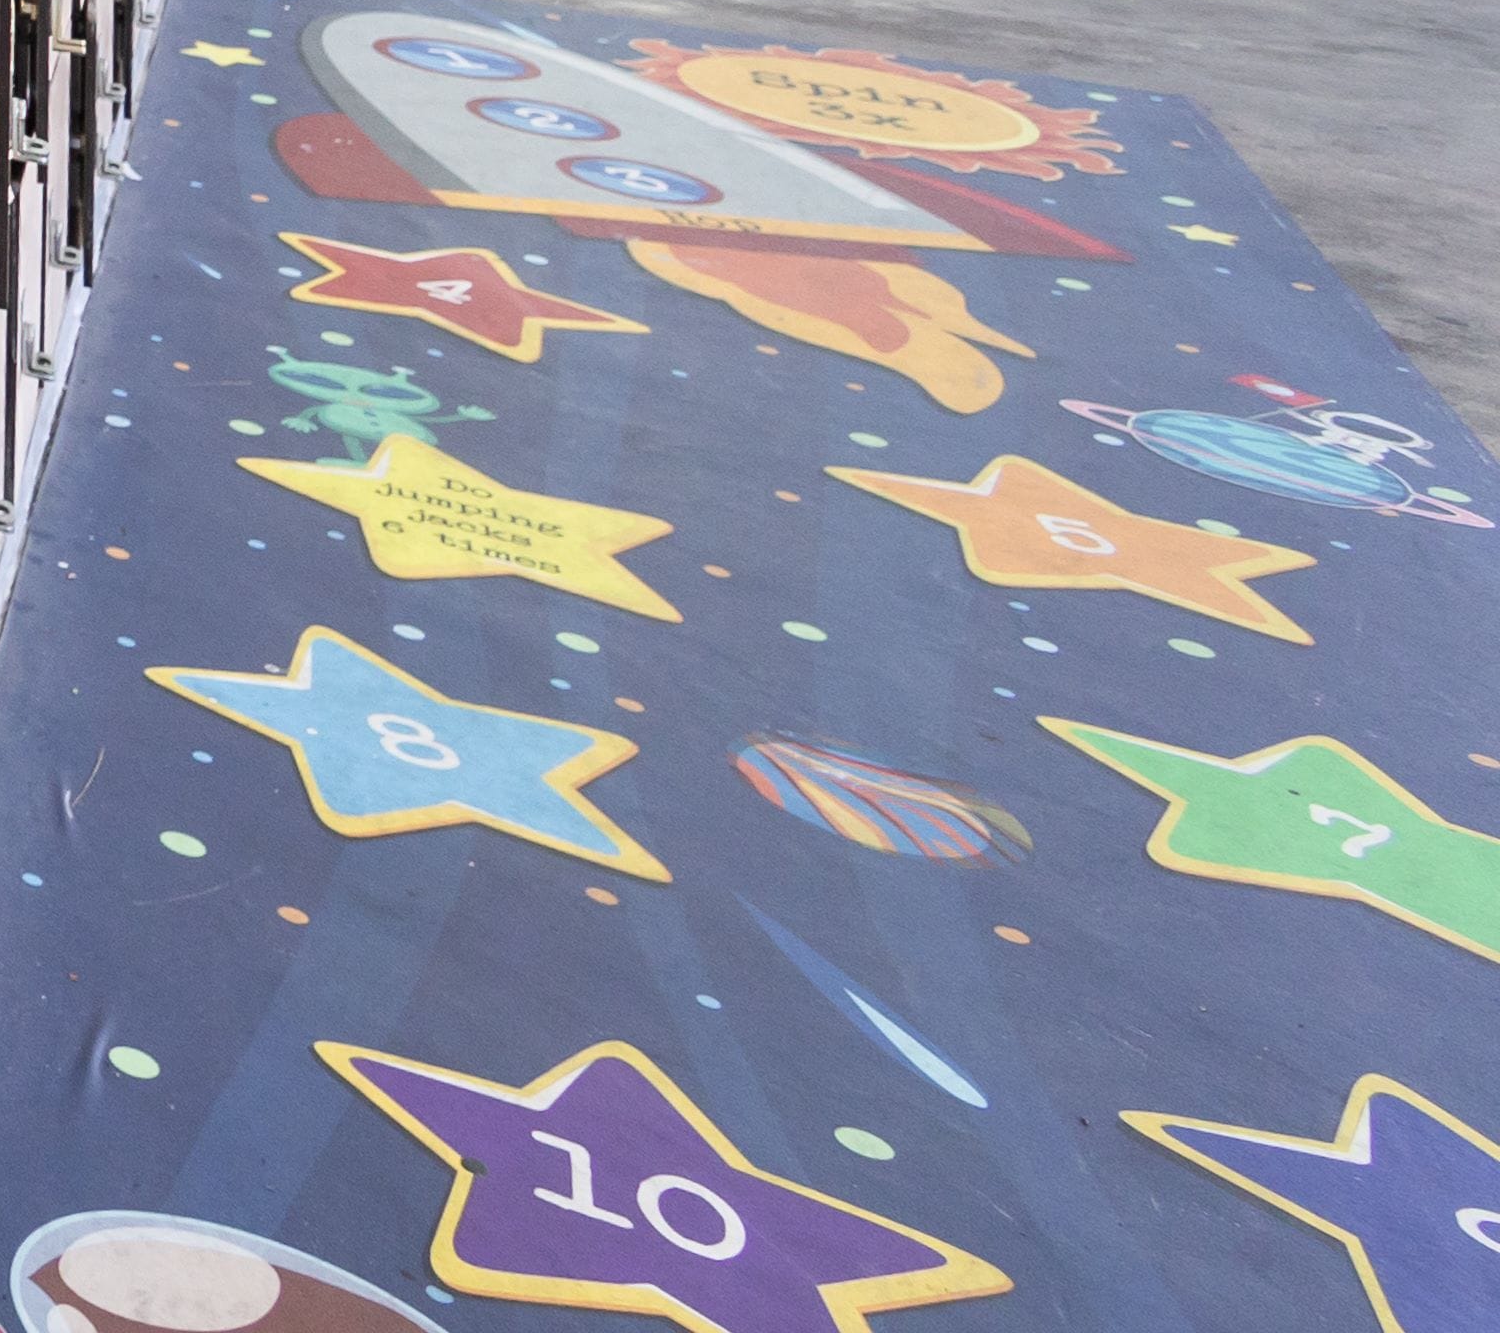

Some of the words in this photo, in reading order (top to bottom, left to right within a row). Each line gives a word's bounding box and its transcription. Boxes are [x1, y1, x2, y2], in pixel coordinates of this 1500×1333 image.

[749, 69, 951, 114] Spin
[513, 106, 575, 134] 2
[807, 100, 915, 132] 3x
[603, 164, 671, 194] 3
[653, 208, 764, 235] Hop
[414, 277, 475, 306] 4
[440, 477, 493, 499] Do
[375, 483, 565, 538] jumping
[407, 509, 532, 547] jacks
[381, 520, 405, 534] 6
[435, 533, 562, 575] times
[1034, 513, 1118, 557] 5
[366, 711, 464, 775] 8
[1307, 802, 1393, 859] 7
[528, 1129, 750, 1265] 10
